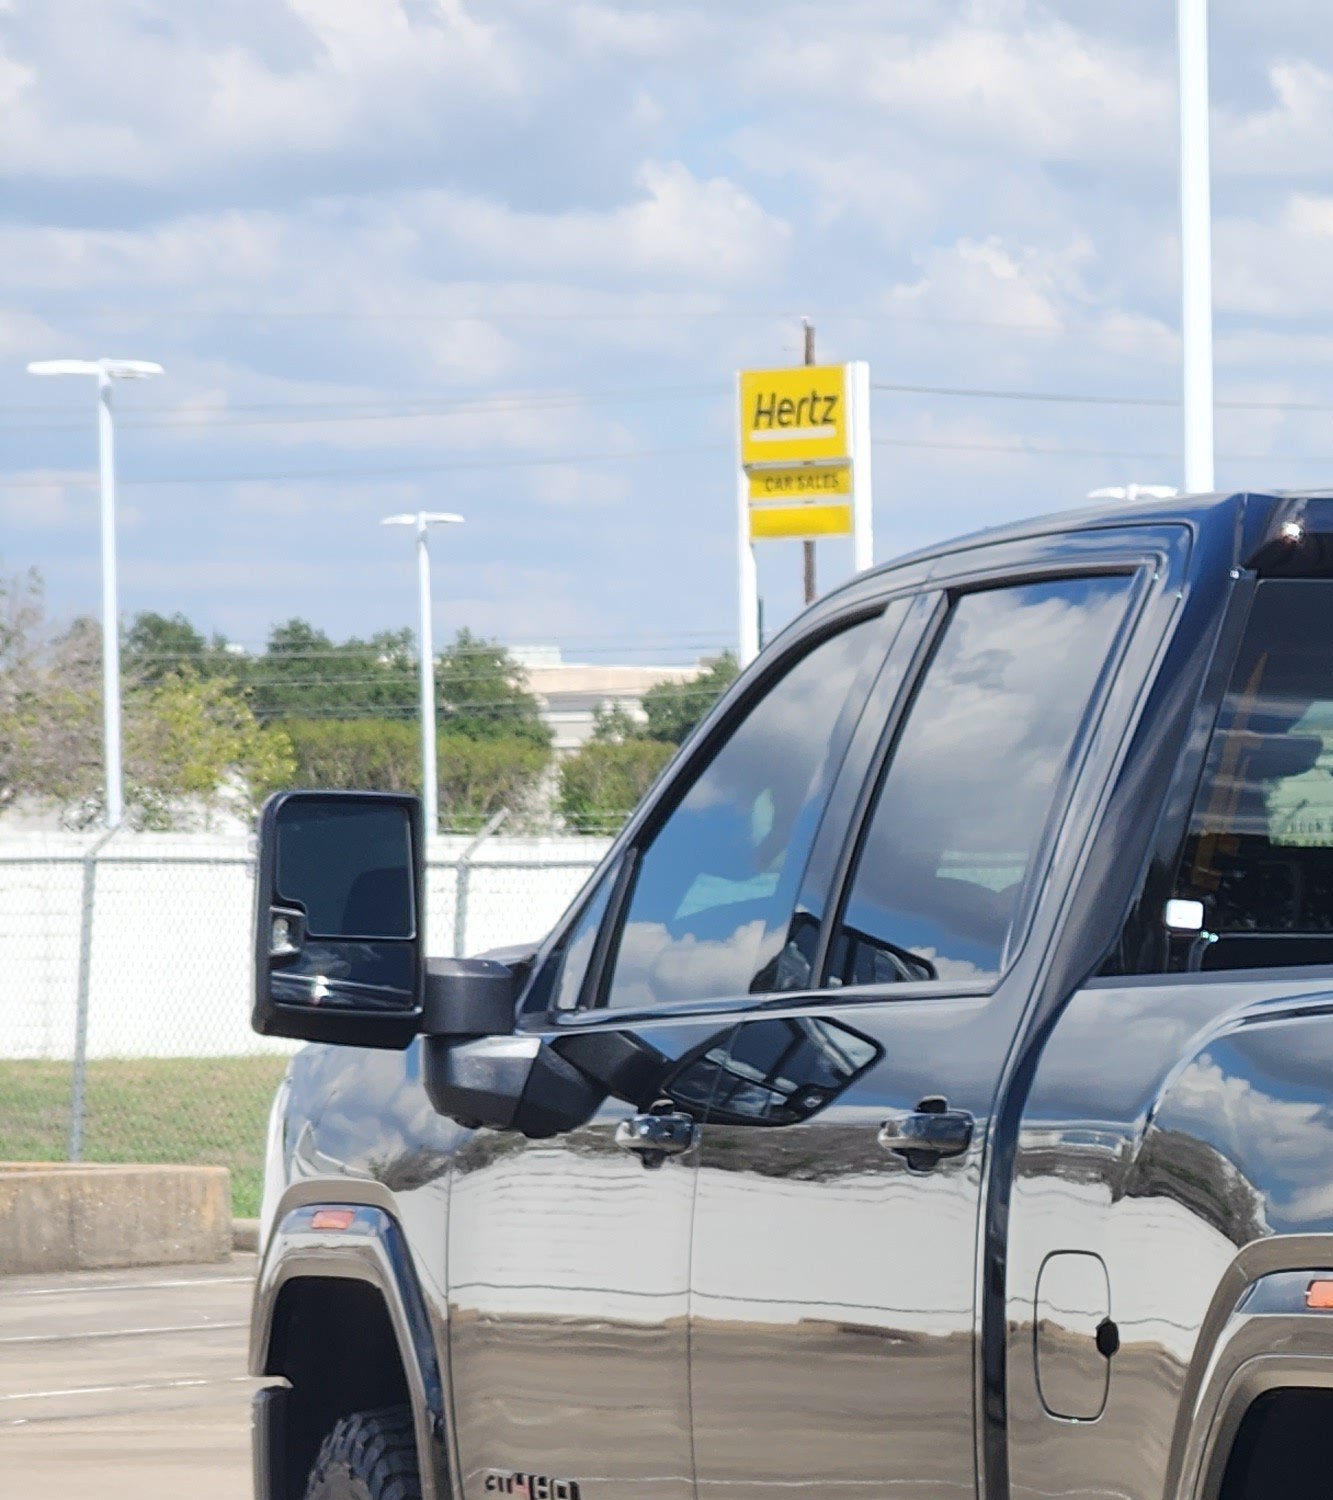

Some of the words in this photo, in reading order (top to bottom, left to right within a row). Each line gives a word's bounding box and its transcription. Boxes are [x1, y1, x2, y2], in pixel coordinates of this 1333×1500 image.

[753, 391, 839, 430] Hertz
[764, 475, 794, 492] CAR
[798, 473, 840, 491] SALES
